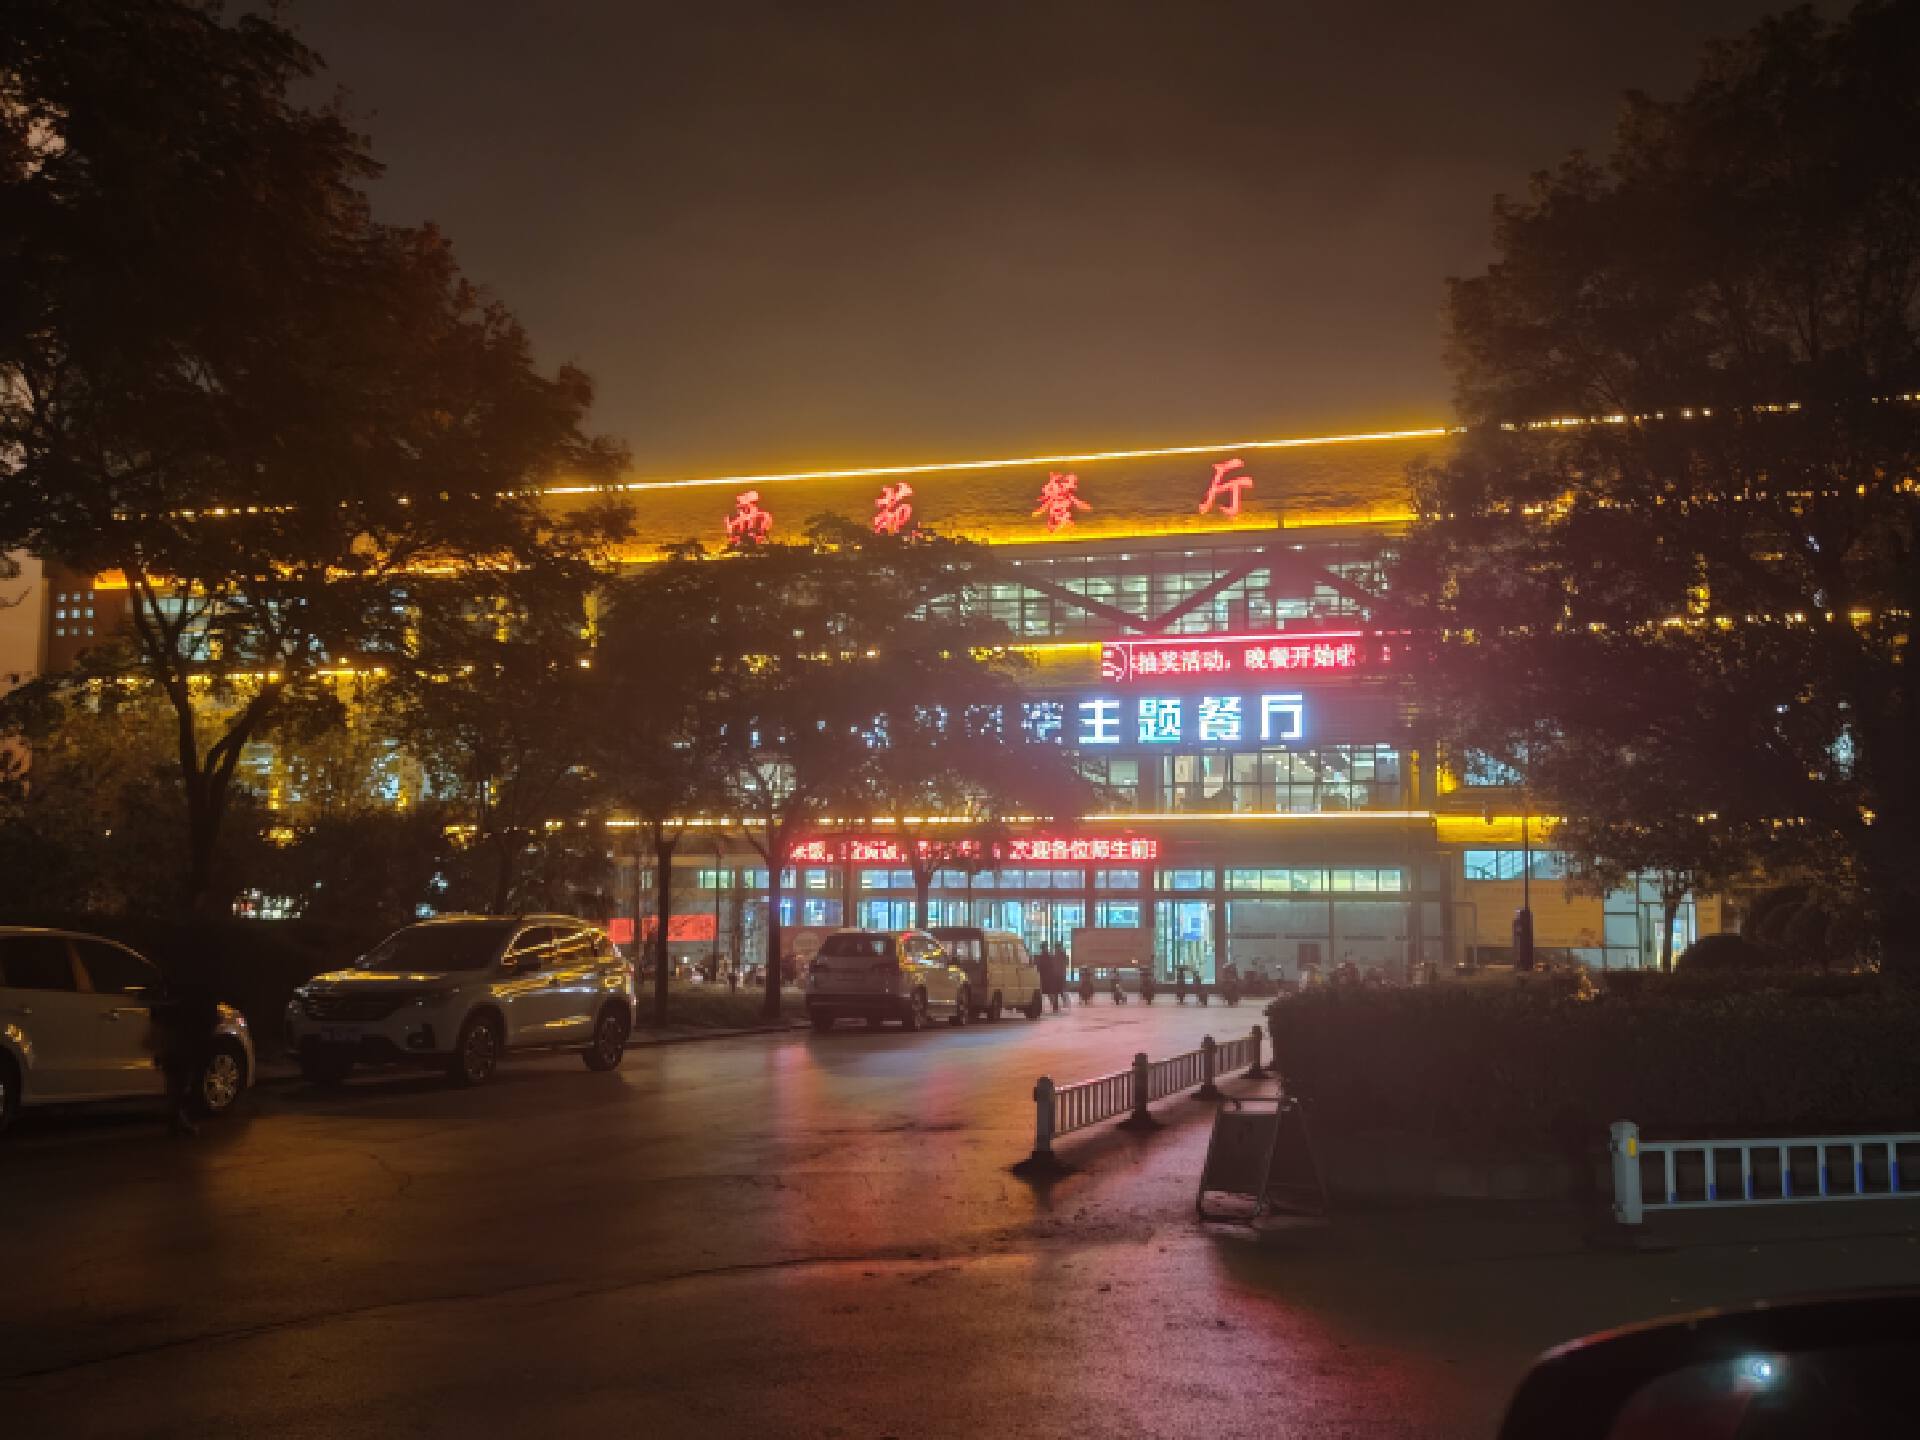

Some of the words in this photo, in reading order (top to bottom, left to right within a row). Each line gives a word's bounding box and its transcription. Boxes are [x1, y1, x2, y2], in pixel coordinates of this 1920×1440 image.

[1079, 692, 1303, 743] 主题餐厅
[1009, 838, 1157, 860] 欢迎各位师生前
